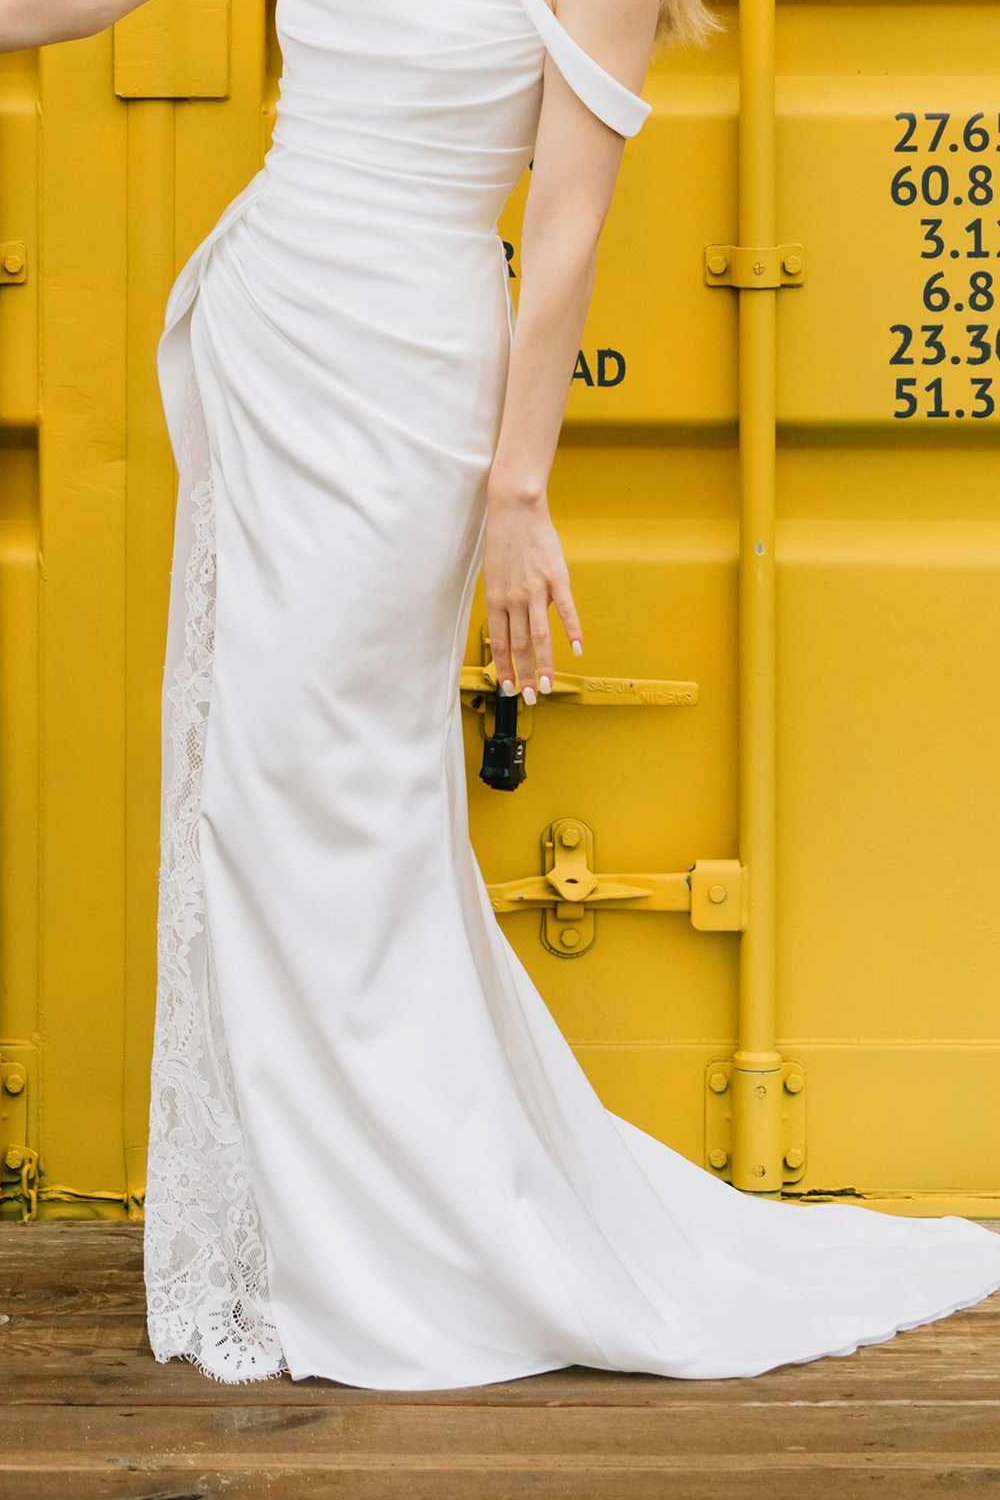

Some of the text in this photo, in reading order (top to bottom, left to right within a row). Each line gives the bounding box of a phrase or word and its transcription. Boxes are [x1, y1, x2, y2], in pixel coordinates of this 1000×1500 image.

[894, 112, 1000, 153] 27.6
[920, 218, 1000, 260] 3.1
[888, 324, 1000, 365] 23.3
